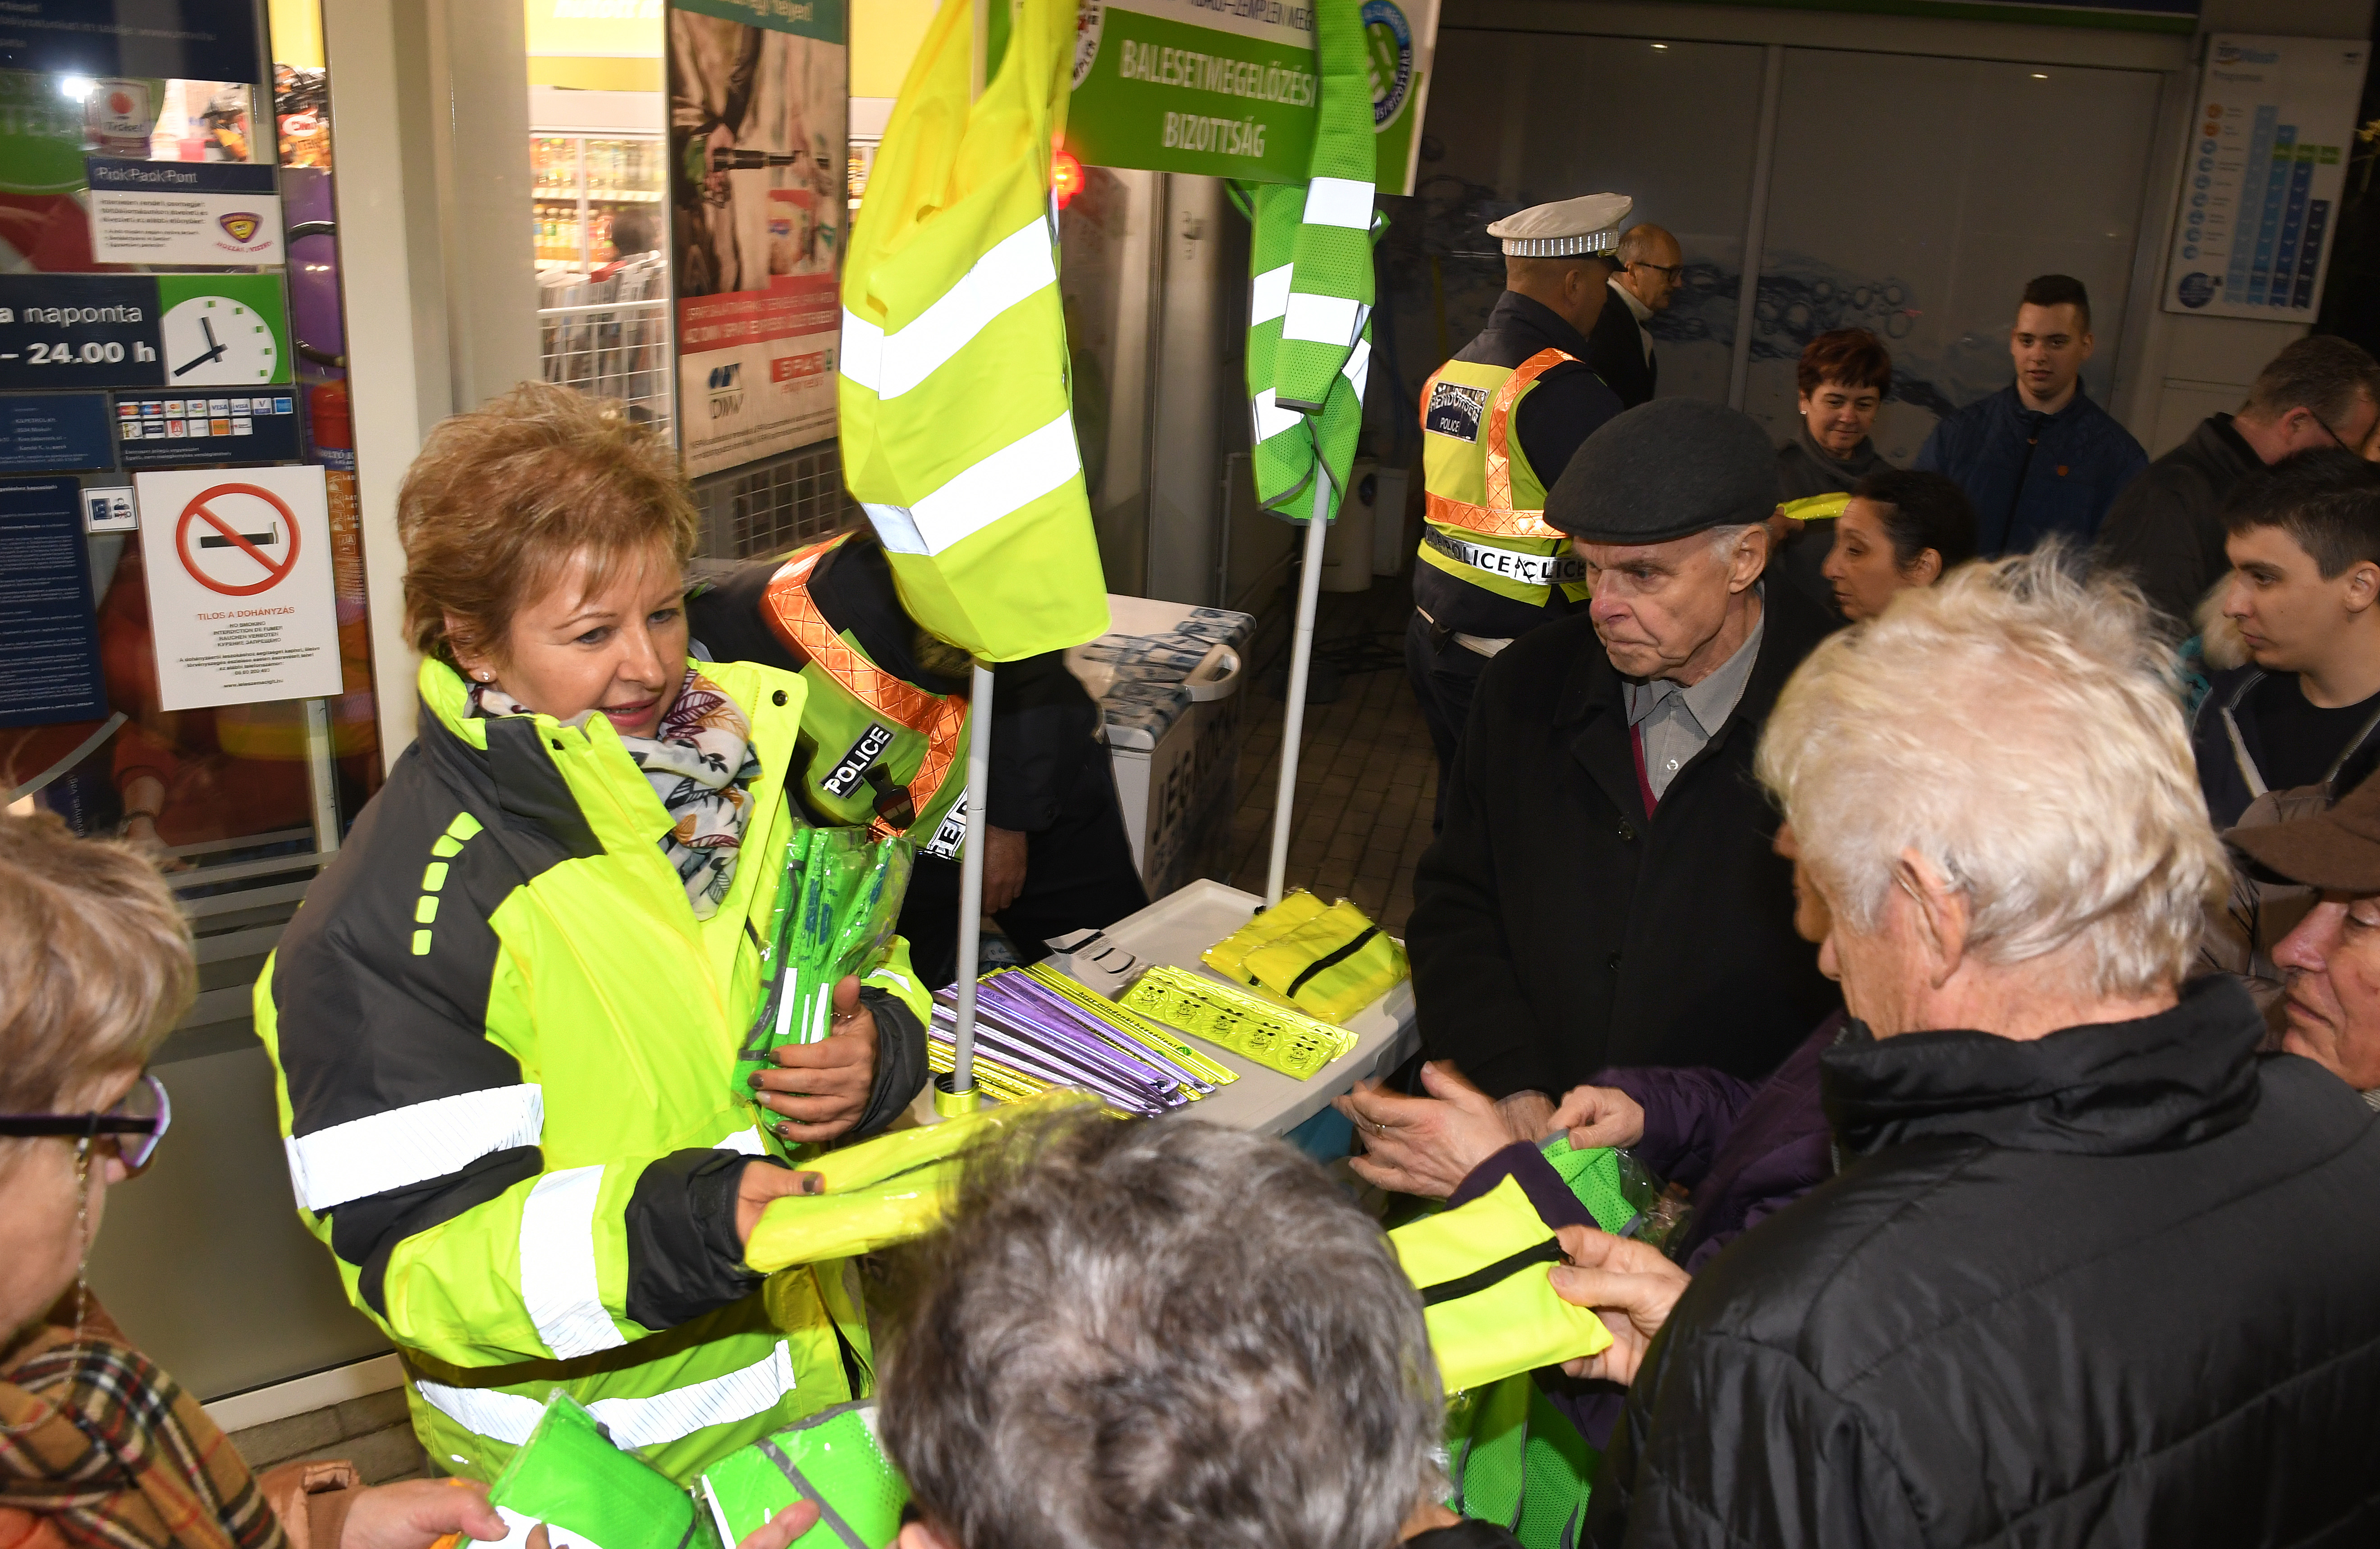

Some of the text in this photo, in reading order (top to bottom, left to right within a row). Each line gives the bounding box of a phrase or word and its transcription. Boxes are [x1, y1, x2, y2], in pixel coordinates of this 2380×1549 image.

[1288, 7, 1313, 32] MEG
[1120, 39, 1318, 108] BALESETMEGELŐZÉSI
[1163, 111, 1267, 158] BIZOTTSÁG
[24, 304, 143, 328] naponta
[26, 342, 125, 364] 24.00
[133, 341, 156, 362] h
[781, 354, 824, 378] SPAR
[1439, 417, 1460, 433] POLICE
[197, 611, 225, 621] TILOS
[237, 605, 295, 618] DOHÁNYZÁS
[823, 726, 891, 794] POLICE
[1098, 1001, 1135, 1024] mindenki
[1134, 1021, 1178, 1048] hazaérjen!
